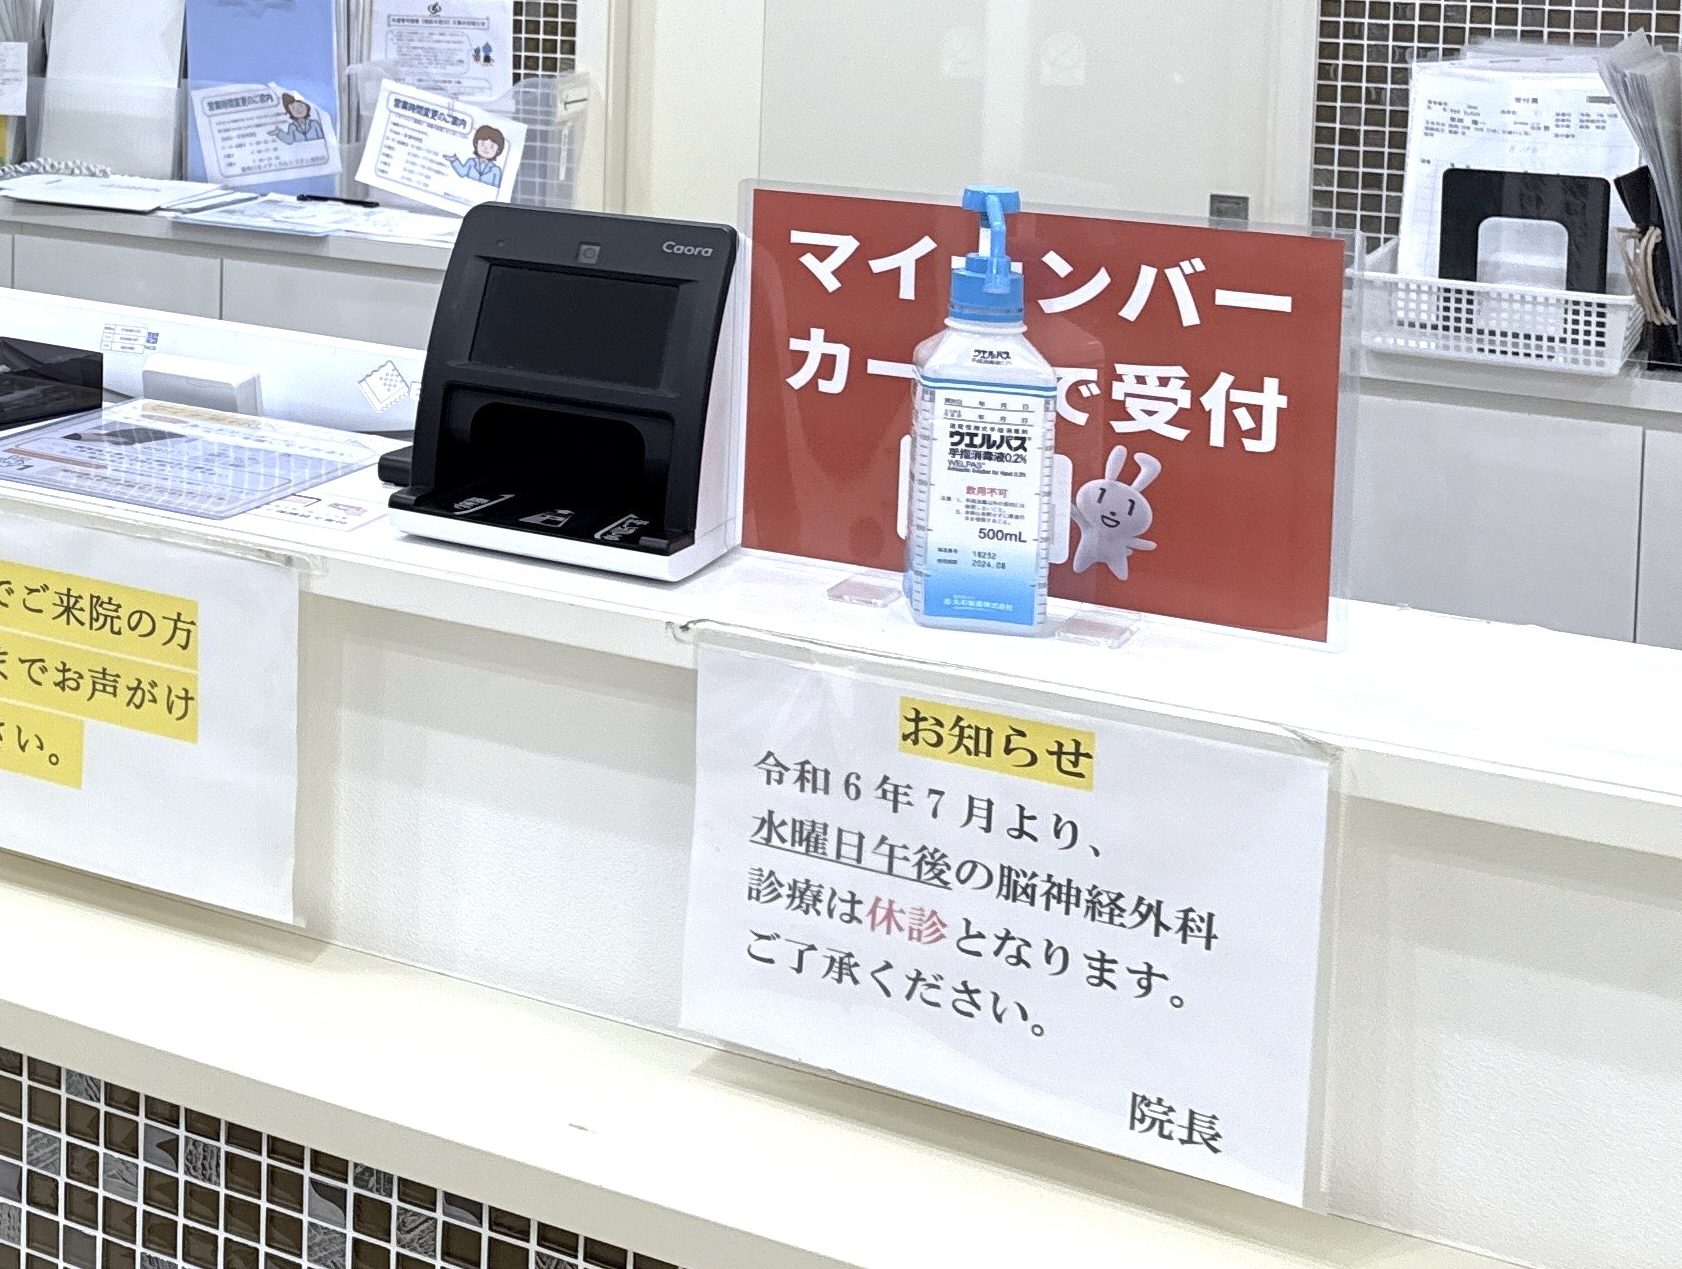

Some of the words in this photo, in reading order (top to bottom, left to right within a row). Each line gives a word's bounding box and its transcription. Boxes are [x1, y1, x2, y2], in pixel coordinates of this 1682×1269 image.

[662, 240, 714, 258] Caora
[789, 229, 1292, 328] マインバー
[973, 349, 1012, 360] ウエルパス
[786, 327, 1288, 453] カーで受付
[948, 447, 1028, 464] 手指消毒液0.2%
[949, 430, 1028, 452] ウエルパス
[965, 485, 1008, 499] 飲用不可
[978, 527, 1028, 543] 500mL
[901, 706, 1094, 780] お知らせ
[752, 750, 1102, 859] 令和6年7月より、
[749, 808, 1219, 952] 水曜日午後の脳神経外科
[746, 866, 1186, 1012] 診療は休診となります。
[745, 929, 1046, 1039] ご了承ください。
[1128, 1091, 1224, 1155] 院長
